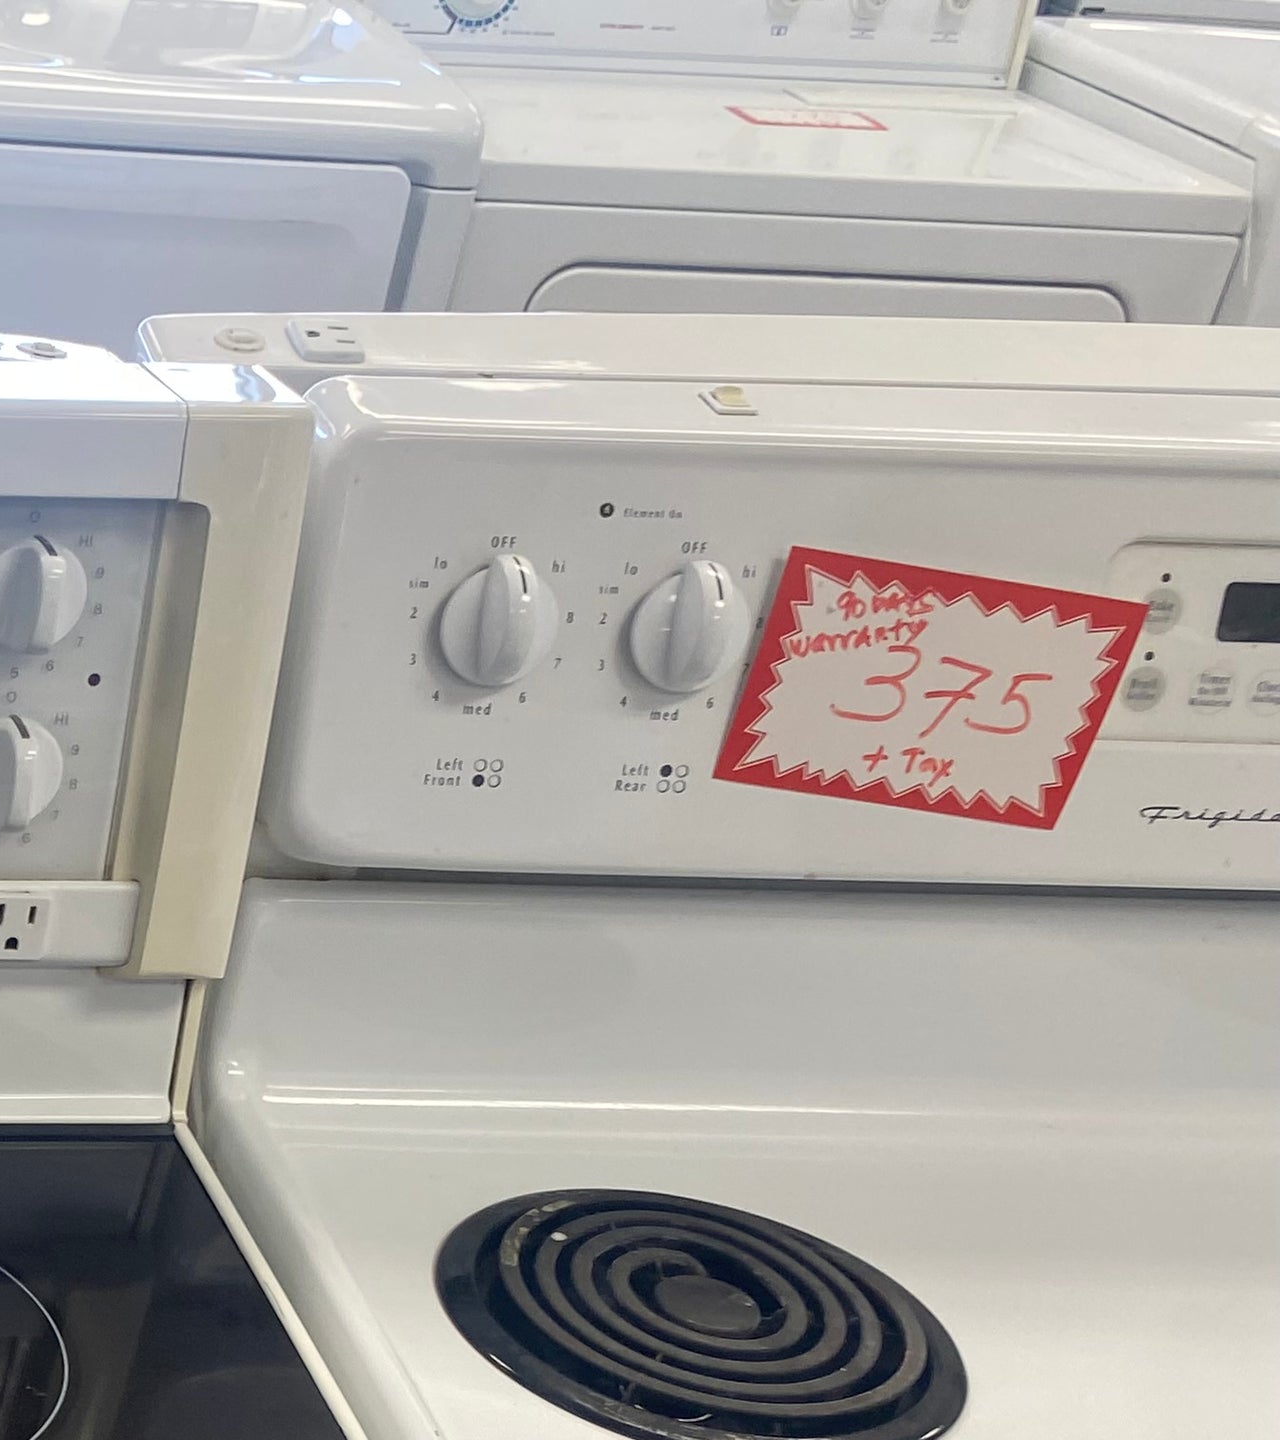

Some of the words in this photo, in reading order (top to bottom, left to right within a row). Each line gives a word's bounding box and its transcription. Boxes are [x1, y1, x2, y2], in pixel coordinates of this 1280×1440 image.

[623, 507, 665, 519] Element
[668, 508, 683, 520] On
[78, 534, 94, 548] HI
[490, 535, 518, 549] OFF
[680, 541, 708, 554] OFF
[433, 556, 448, 570] lo
[552, 560, 566, 574] hi
[624, 561, 638, 576] lo
[94, 566, 105, 579] 9
[741, 564, 757, 579] hi
[408, 578, 430, 589] sim
[598, 584, 620, 595] sim
[93, 603, 103, 615] 8
[409, 606, 419, 619] 2
[566, 611, 575, 624] 8
[598, 611, 608, 625] 2
[45, 659, 55, 672] 6
[408, 653, 417, 666] 3
[553, 657, 562, 670] 7
[597, 659, 606, 672] 3
[9, 666, 20, 679] 5
[431, 690, 440, 702] 4
[518, 691, 527, 704] 6
[830, 644, 1054, 740] 375
[619, 695, 628, 708] 4
[706, 696, 715, 710] 6
[462, 702, 493, 716] med
[649, 708, 680, 722] med
[53, 713, 69, 726] HI
[70, 743, 81, 756] 9
[436, 757, 464, 771] Left
[862, 745, 889, 773] +
[901, 746, 955, 787] Tax
[621, 764, 650, 778] Left
[68, 778, 79, 790] 8
[423, 774, 462, 787] Front
[614, 779, 648, 792] Rear
[21, 832, 32, 845] 6
